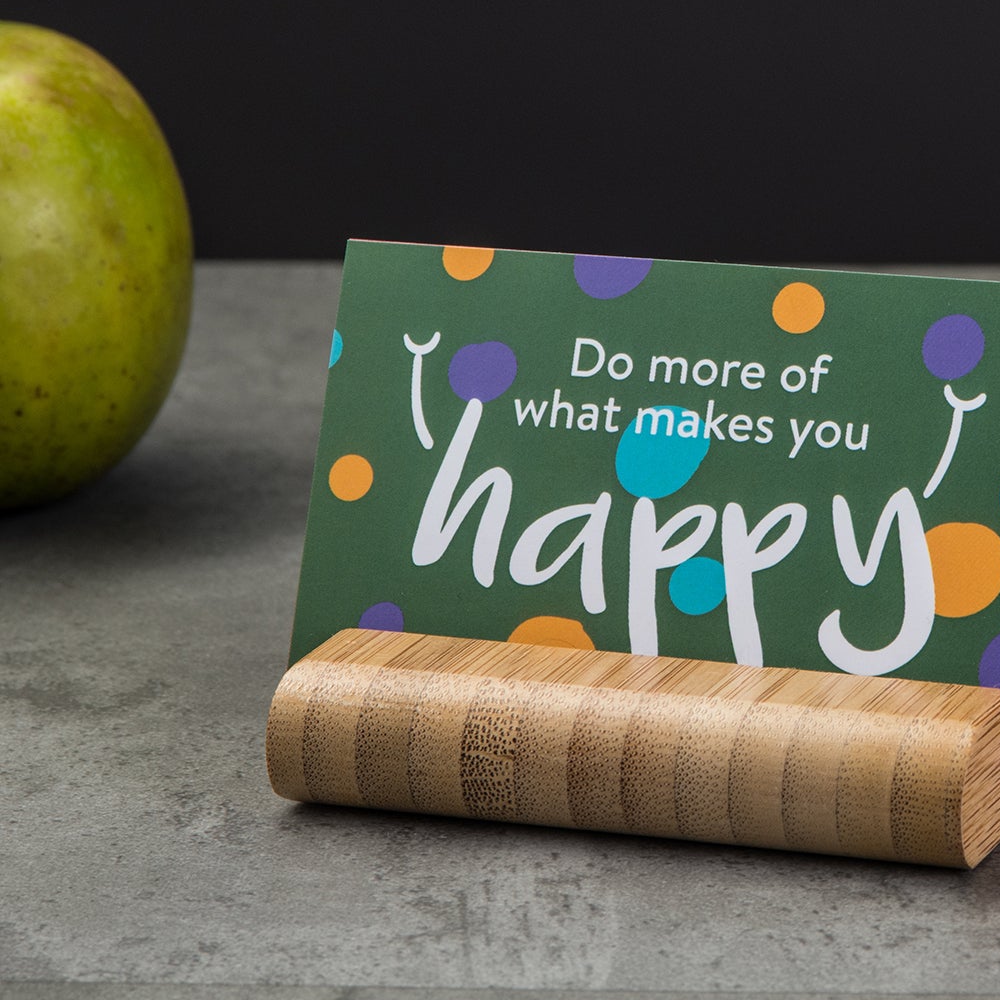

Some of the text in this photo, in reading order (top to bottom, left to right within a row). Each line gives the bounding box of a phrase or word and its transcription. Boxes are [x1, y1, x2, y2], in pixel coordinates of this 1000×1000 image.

[570, 337, 833, 394] Do more of
[514, 388, 869, 459] what makes you
[412, 398, 936, 676] happy
